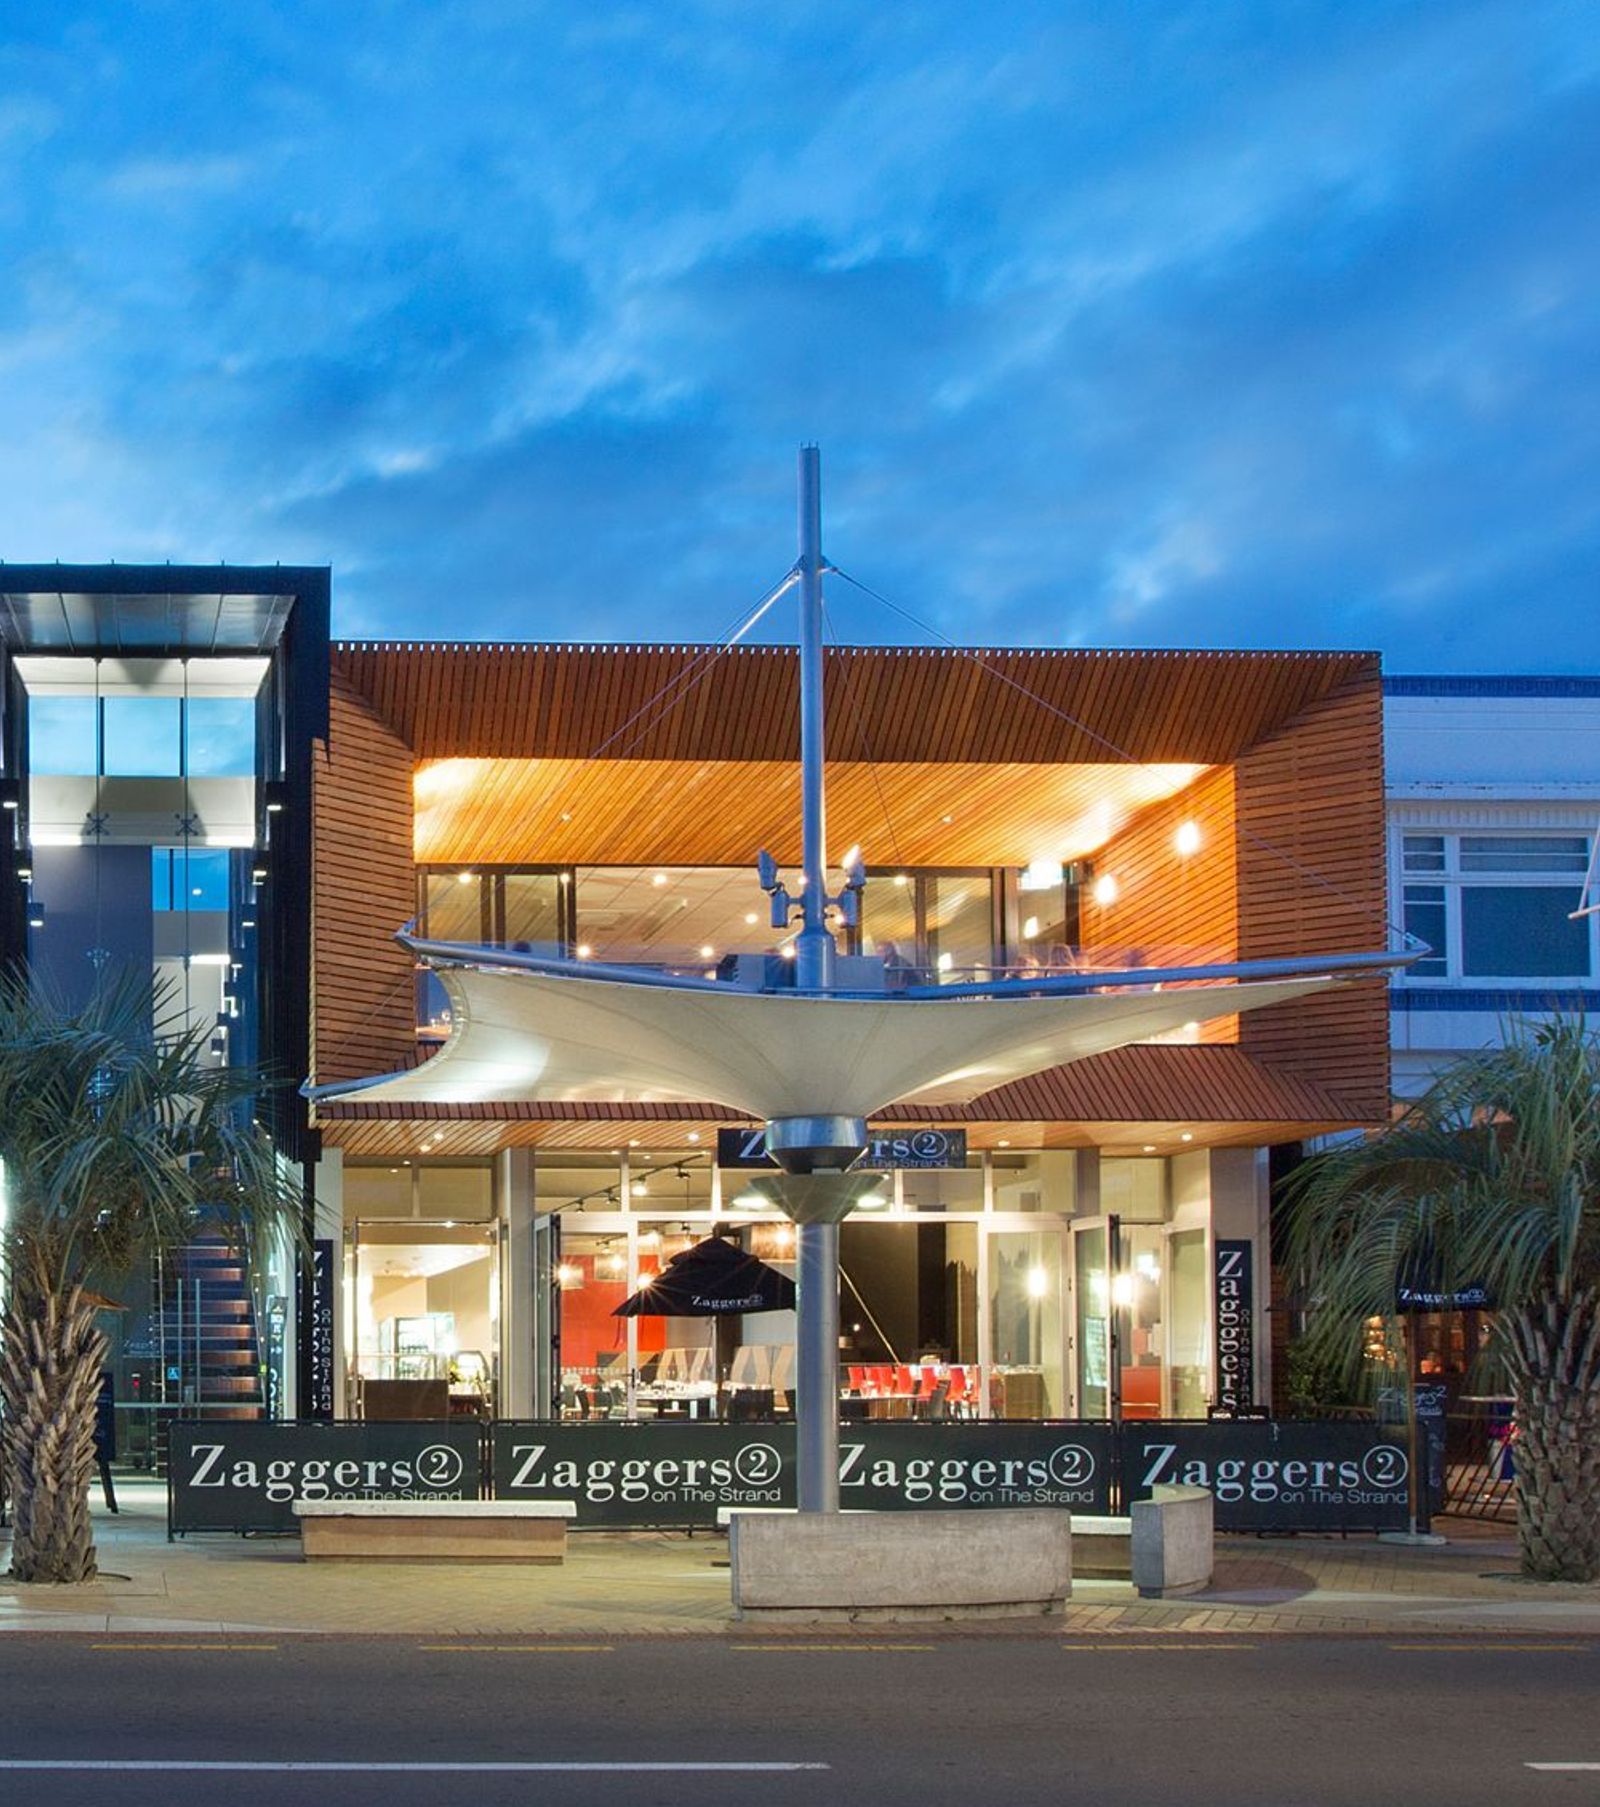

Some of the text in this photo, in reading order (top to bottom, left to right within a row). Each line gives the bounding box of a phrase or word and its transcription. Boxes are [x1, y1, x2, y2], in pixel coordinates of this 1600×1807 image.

[1400, 1288, 1468, 1303] Zaggrs
[1218, 1251, 1243, 1409] Zaggers
[189, 1444, 413, 1502] Zaggers
[510, 1445, 733, 1502] Zaggers
[838, 1444, 1049, 1502] Zaggers
[1141, 1444, 1360, 1502] Zaggers
[331, 1488, 462, 1500] on The Strand
[651, 1487, 782, 1502] on The Strand
[969, 1488, 1094, 1503] on The Strand
[1280, 1488, 1409, 1504] on The Strand
